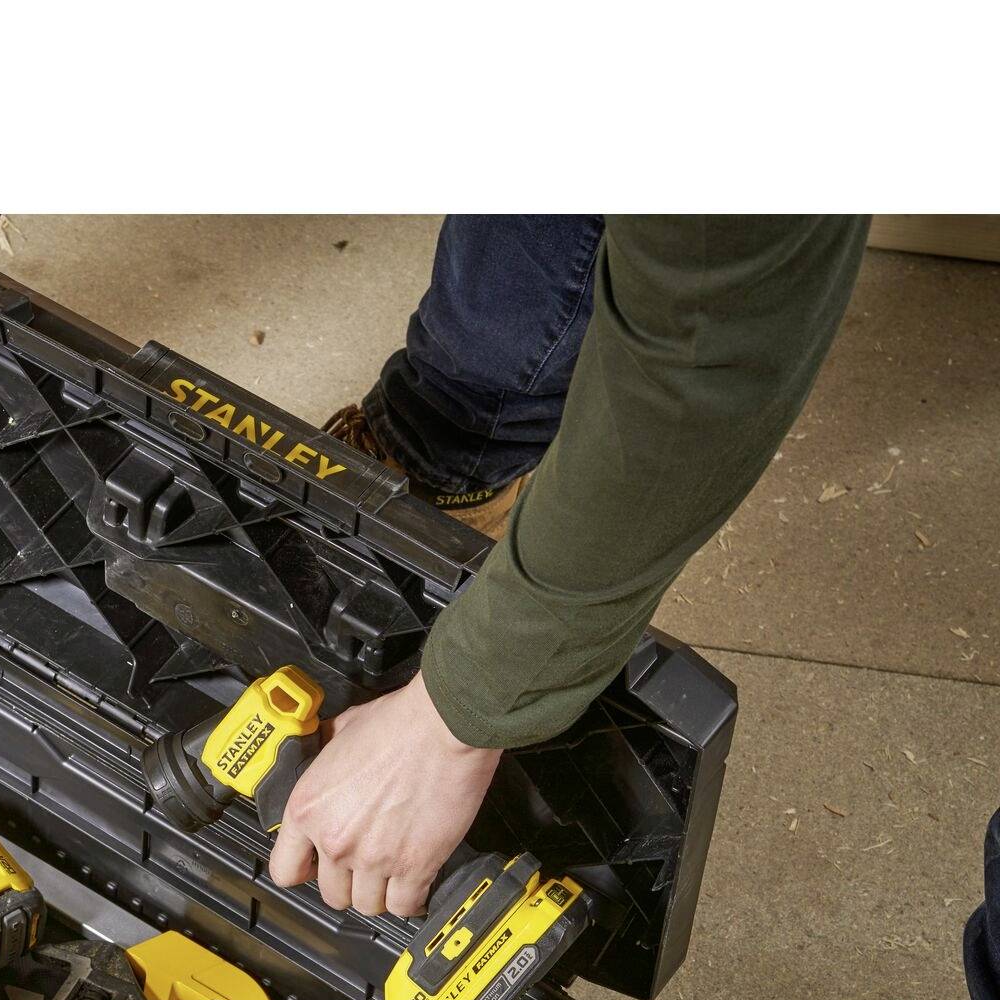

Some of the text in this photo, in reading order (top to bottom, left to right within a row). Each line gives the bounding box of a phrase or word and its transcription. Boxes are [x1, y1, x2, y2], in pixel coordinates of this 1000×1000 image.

[166, 379, 347, 480] STANLEY
[435, 489, 494, 505] STANLEY
[217, 713, 263, 770] STANLEY
[230, 725, 272, 777] FATMAX
[475, 932, 509, 971] FATMAX
[507, 955, 529, 979] 2.0
